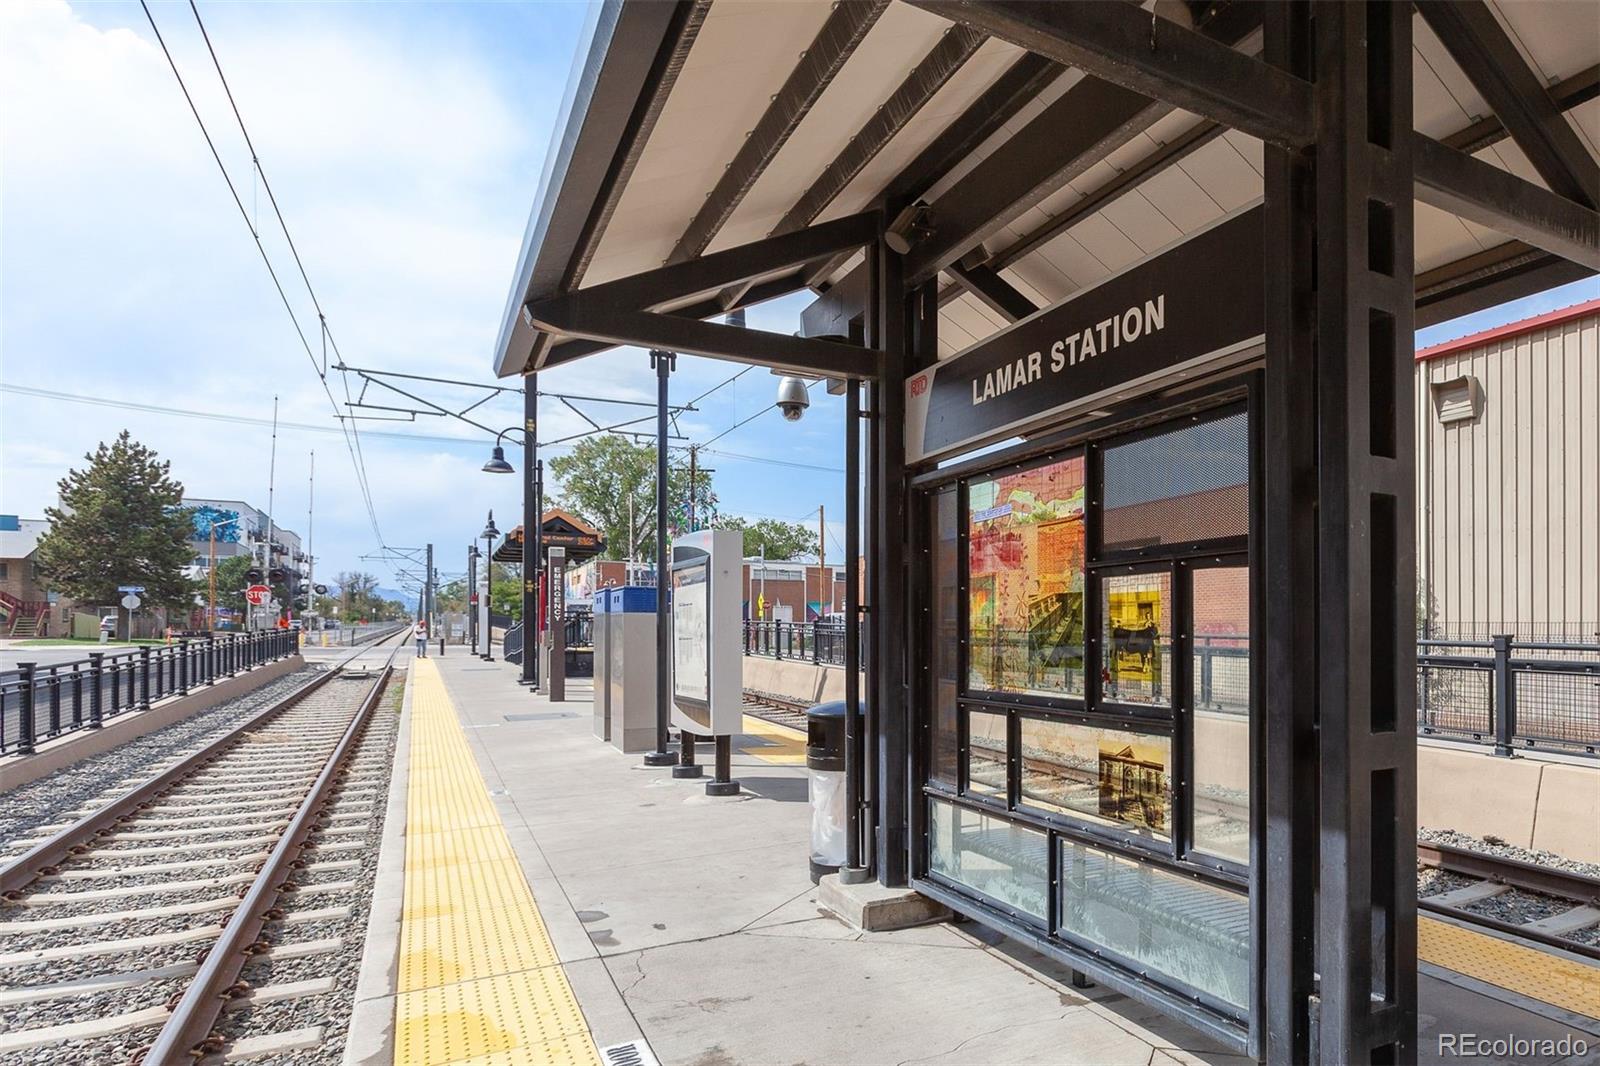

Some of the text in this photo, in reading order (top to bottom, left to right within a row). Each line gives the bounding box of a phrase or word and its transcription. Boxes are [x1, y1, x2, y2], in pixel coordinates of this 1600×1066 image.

[972, 294, 1165, 405] LAMAR STATION
[248, 591, 266, 599] STO
[606, 1043, 643, 1066] OOR
